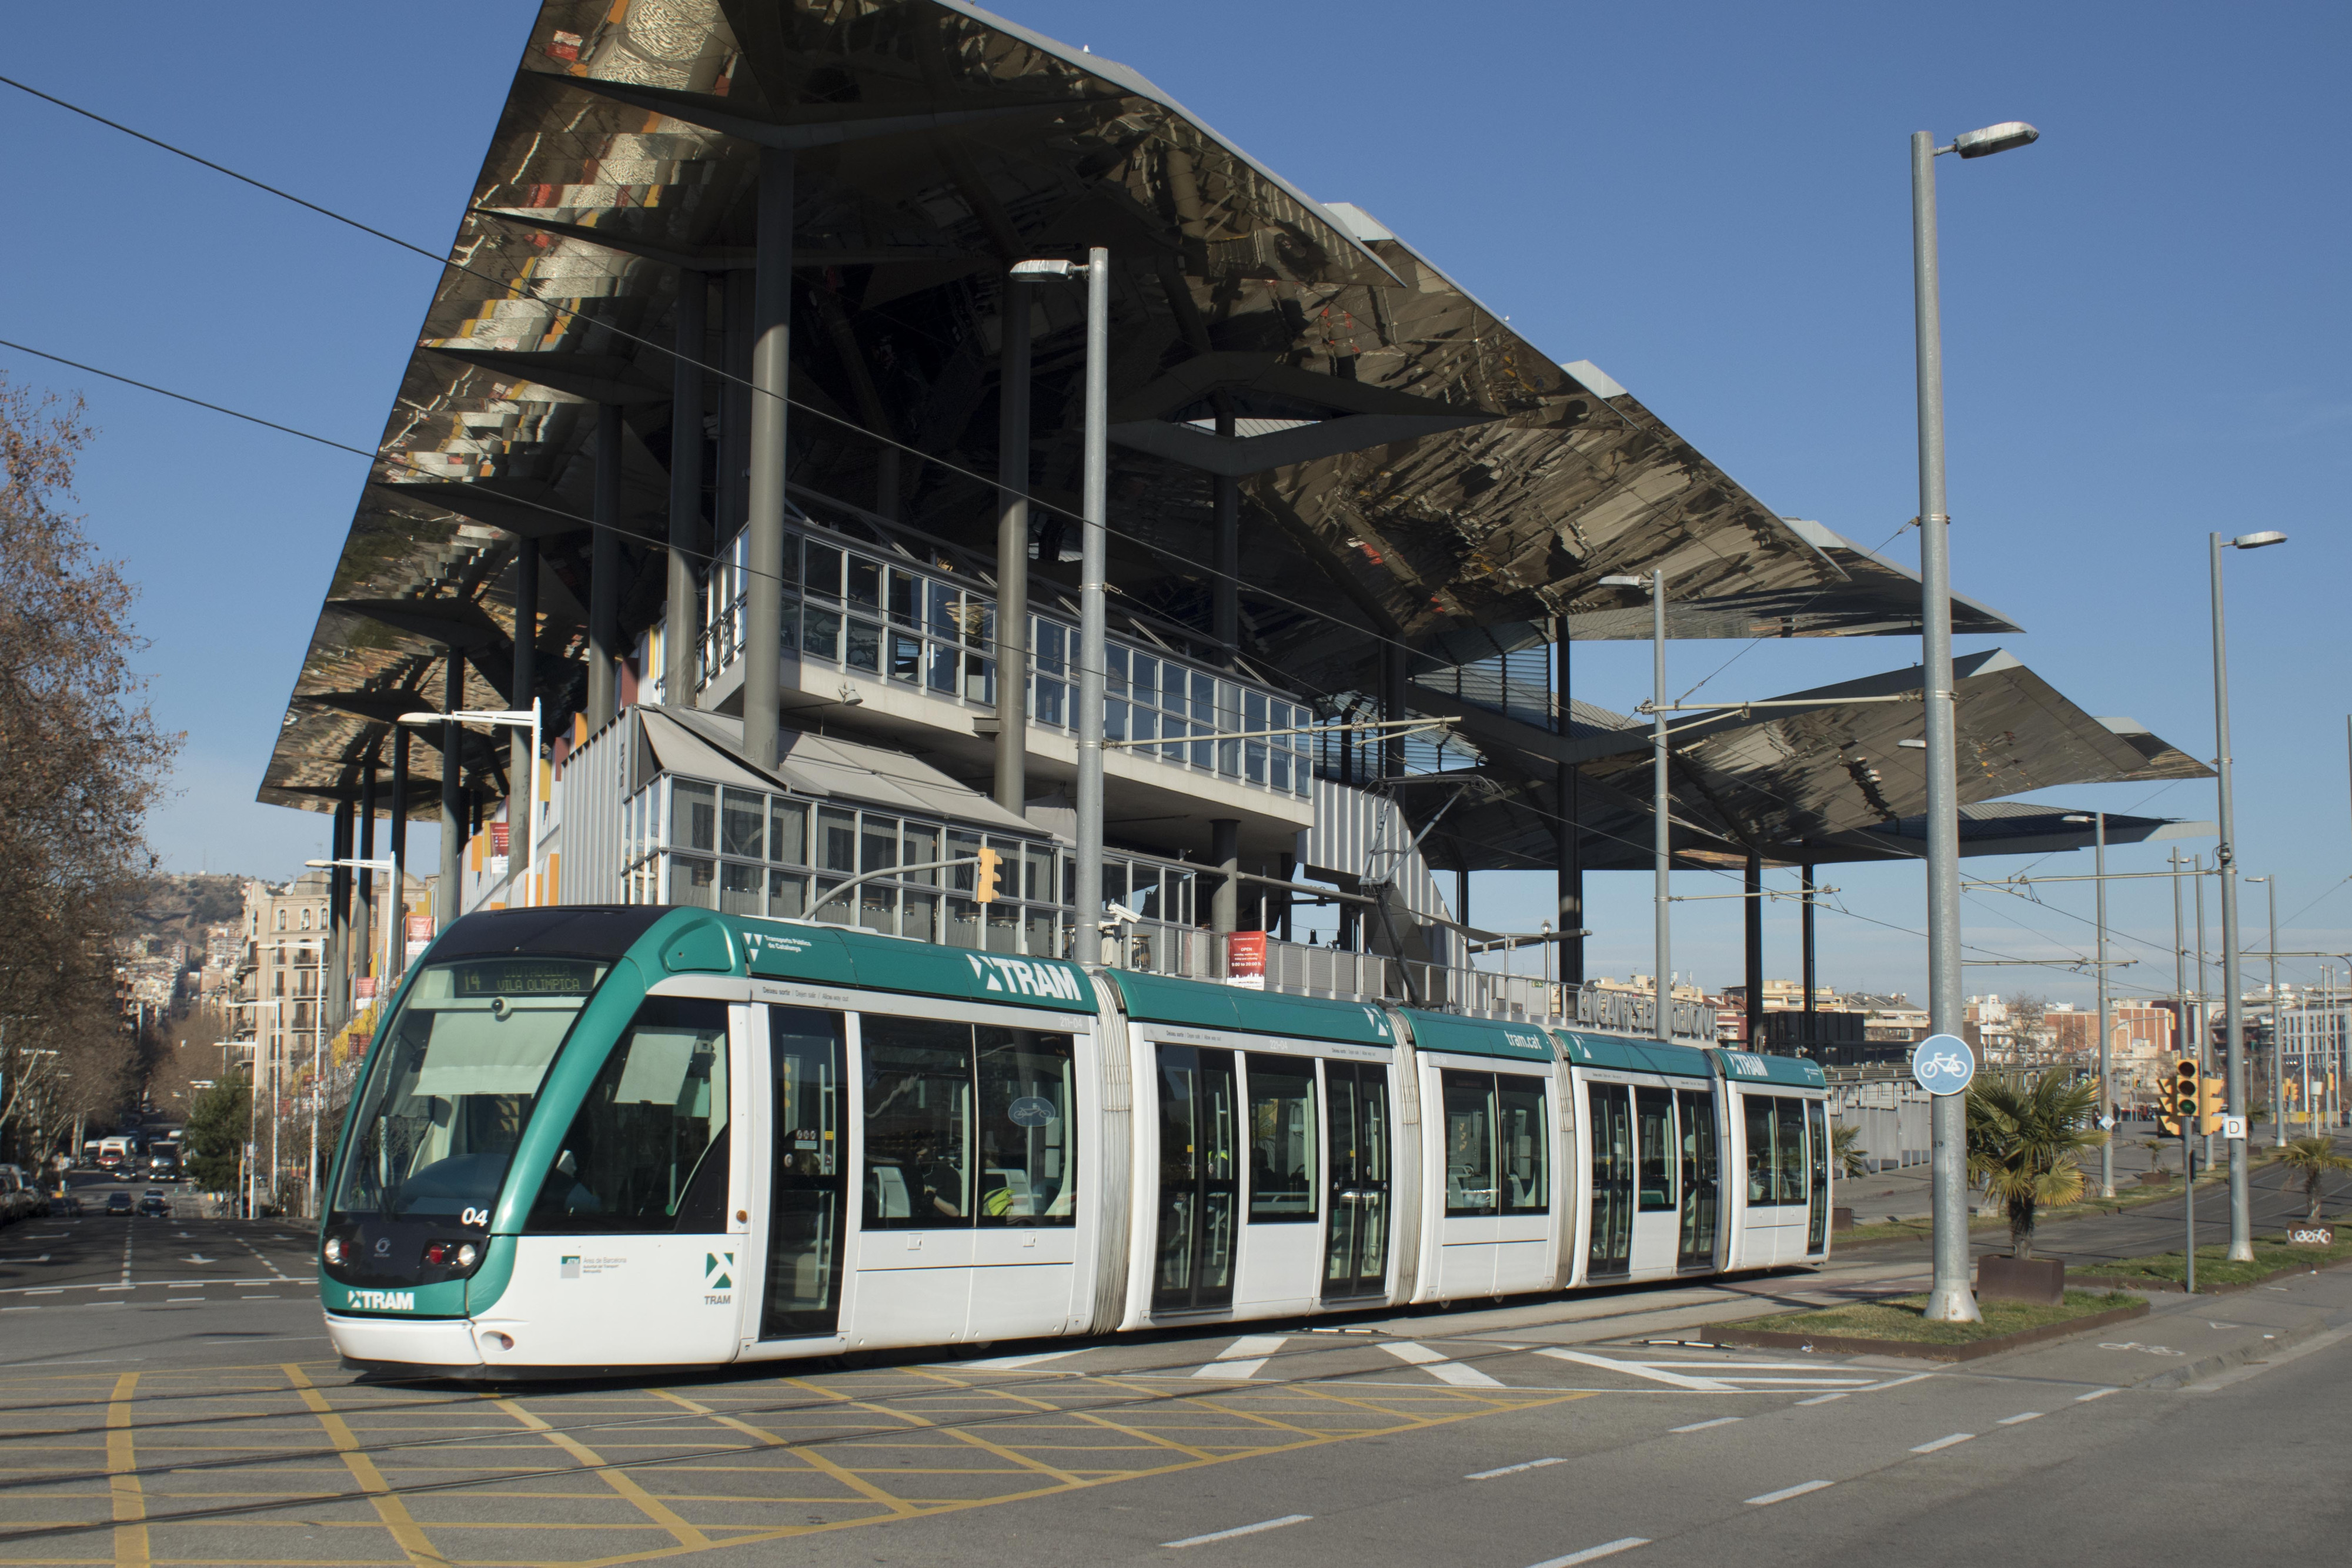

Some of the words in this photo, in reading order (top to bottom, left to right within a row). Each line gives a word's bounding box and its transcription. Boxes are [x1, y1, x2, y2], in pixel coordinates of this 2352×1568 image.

[503, 965, 570, 977] CIUTADELLA
[989, 957, 1082, 1001] TRAM
[497, 979, 523, 991] VILA
[527, 978, 580, 991] OLIMPICA
[1060, 1016, 1083, 1028] 211-04
[1578, 991, 1642, 1028] ENCANTS
[1643, 998, 1716, 1037] BCELONA
[1269, 1039, 1288, 1050] 221-04
[1504, 1030, 1542, 1049] tram.cat
[1735, 1054, 1768, 1076] TRAM
[2229, 1121, 2239, 1134] D
[461, 1207, 489, 1226] 04
[362, 1290, 414, 1310] TRAM
[704, 1295, 731, 1305] TRAM
